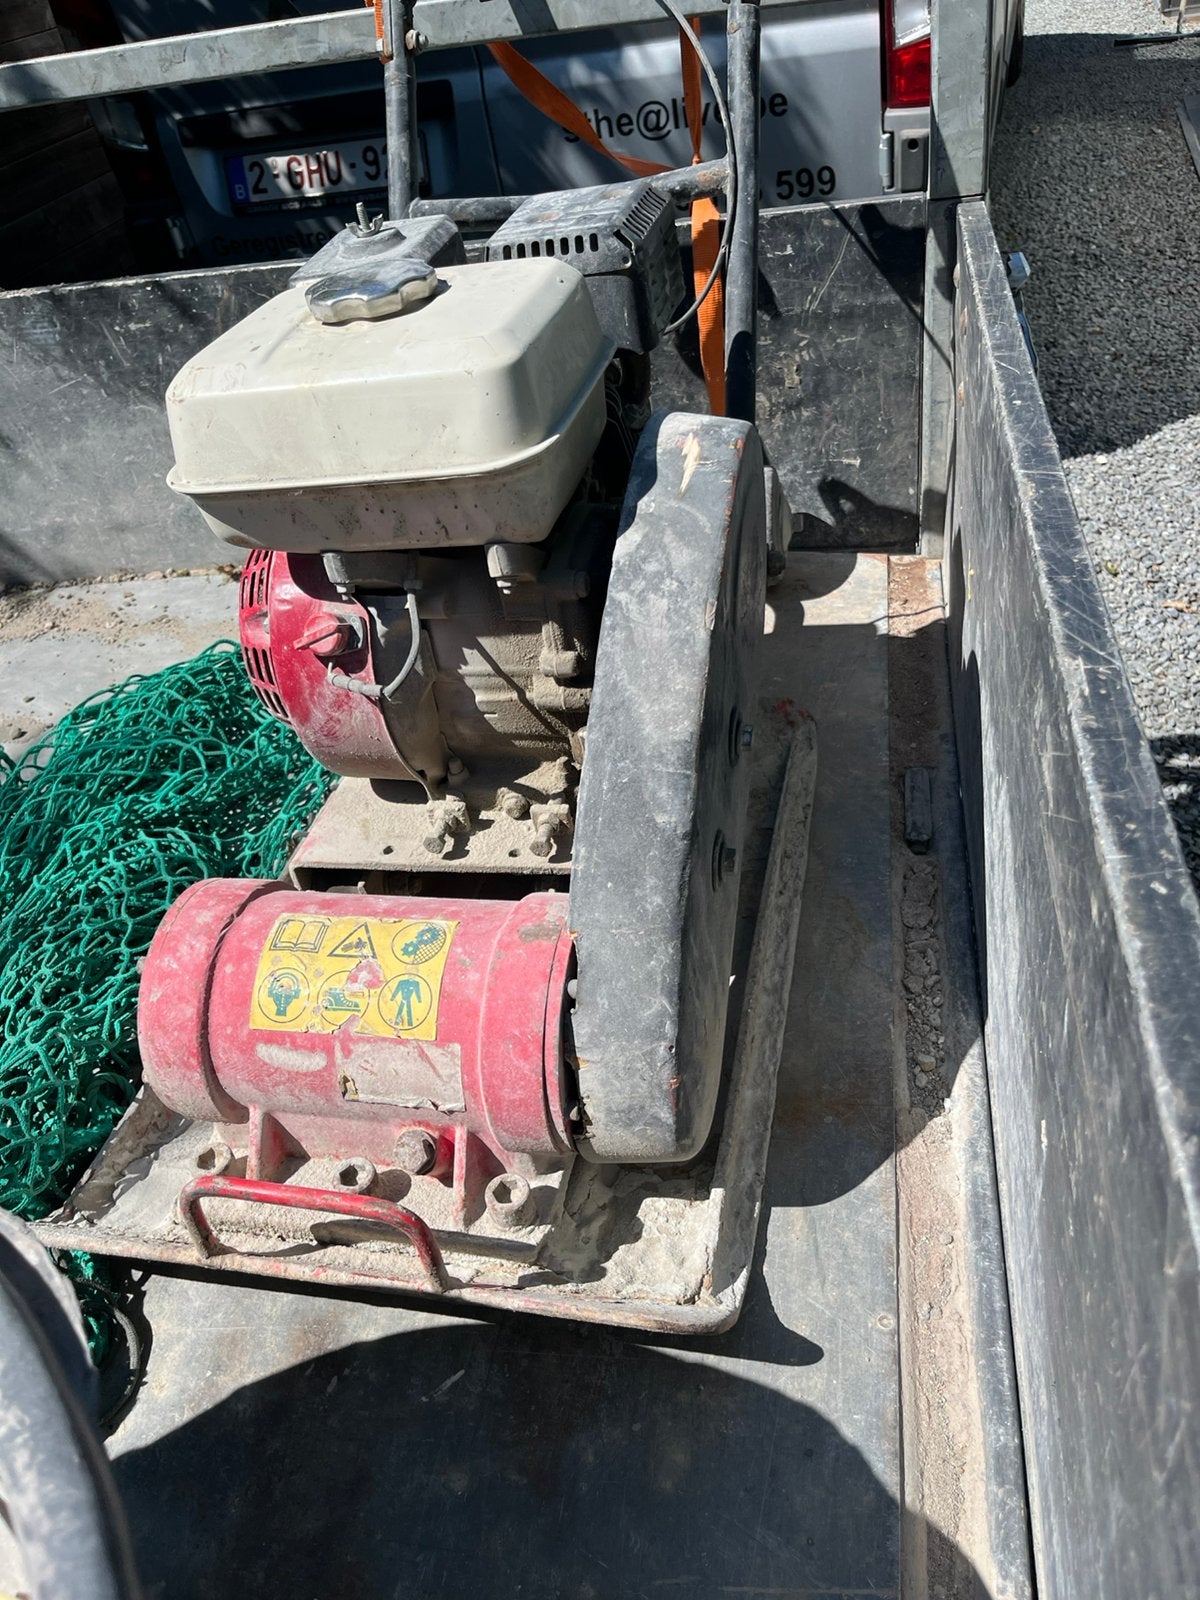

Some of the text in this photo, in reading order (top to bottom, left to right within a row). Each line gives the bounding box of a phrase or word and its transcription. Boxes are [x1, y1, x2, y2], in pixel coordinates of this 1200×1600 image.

[248, 145, 388, 195] 2-GHU-9
[776, 165, 837, 200] 599
[235, 184, 246, 200] B
